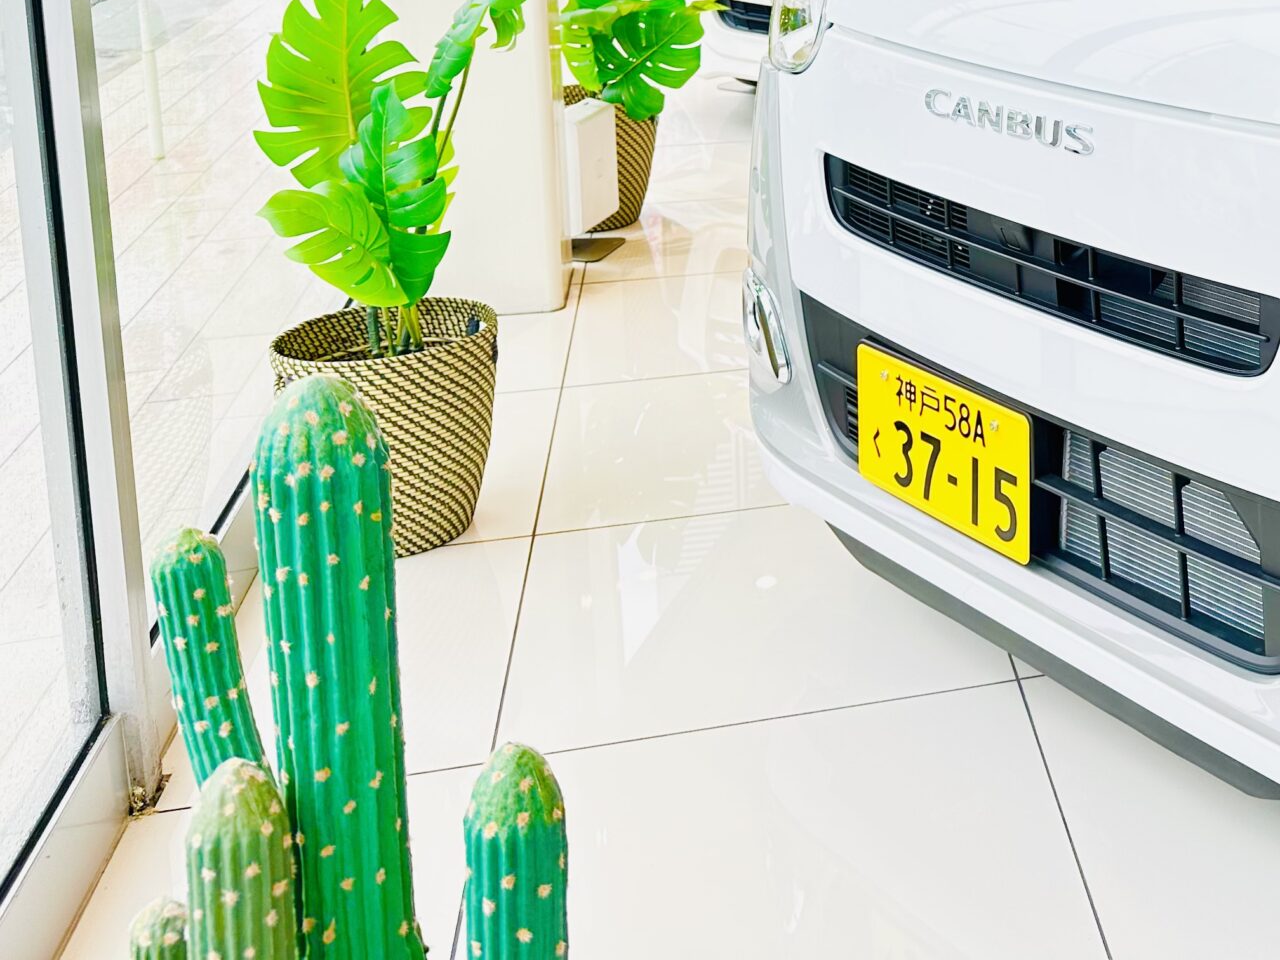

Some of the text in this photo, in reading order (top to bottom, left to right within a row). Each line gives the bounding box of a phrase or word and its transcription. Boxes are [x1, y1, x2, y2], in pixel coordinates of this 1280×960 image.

[925, 89, 1094, 155] CANBUS
[873, 420, 1017, 542] く 37-15
